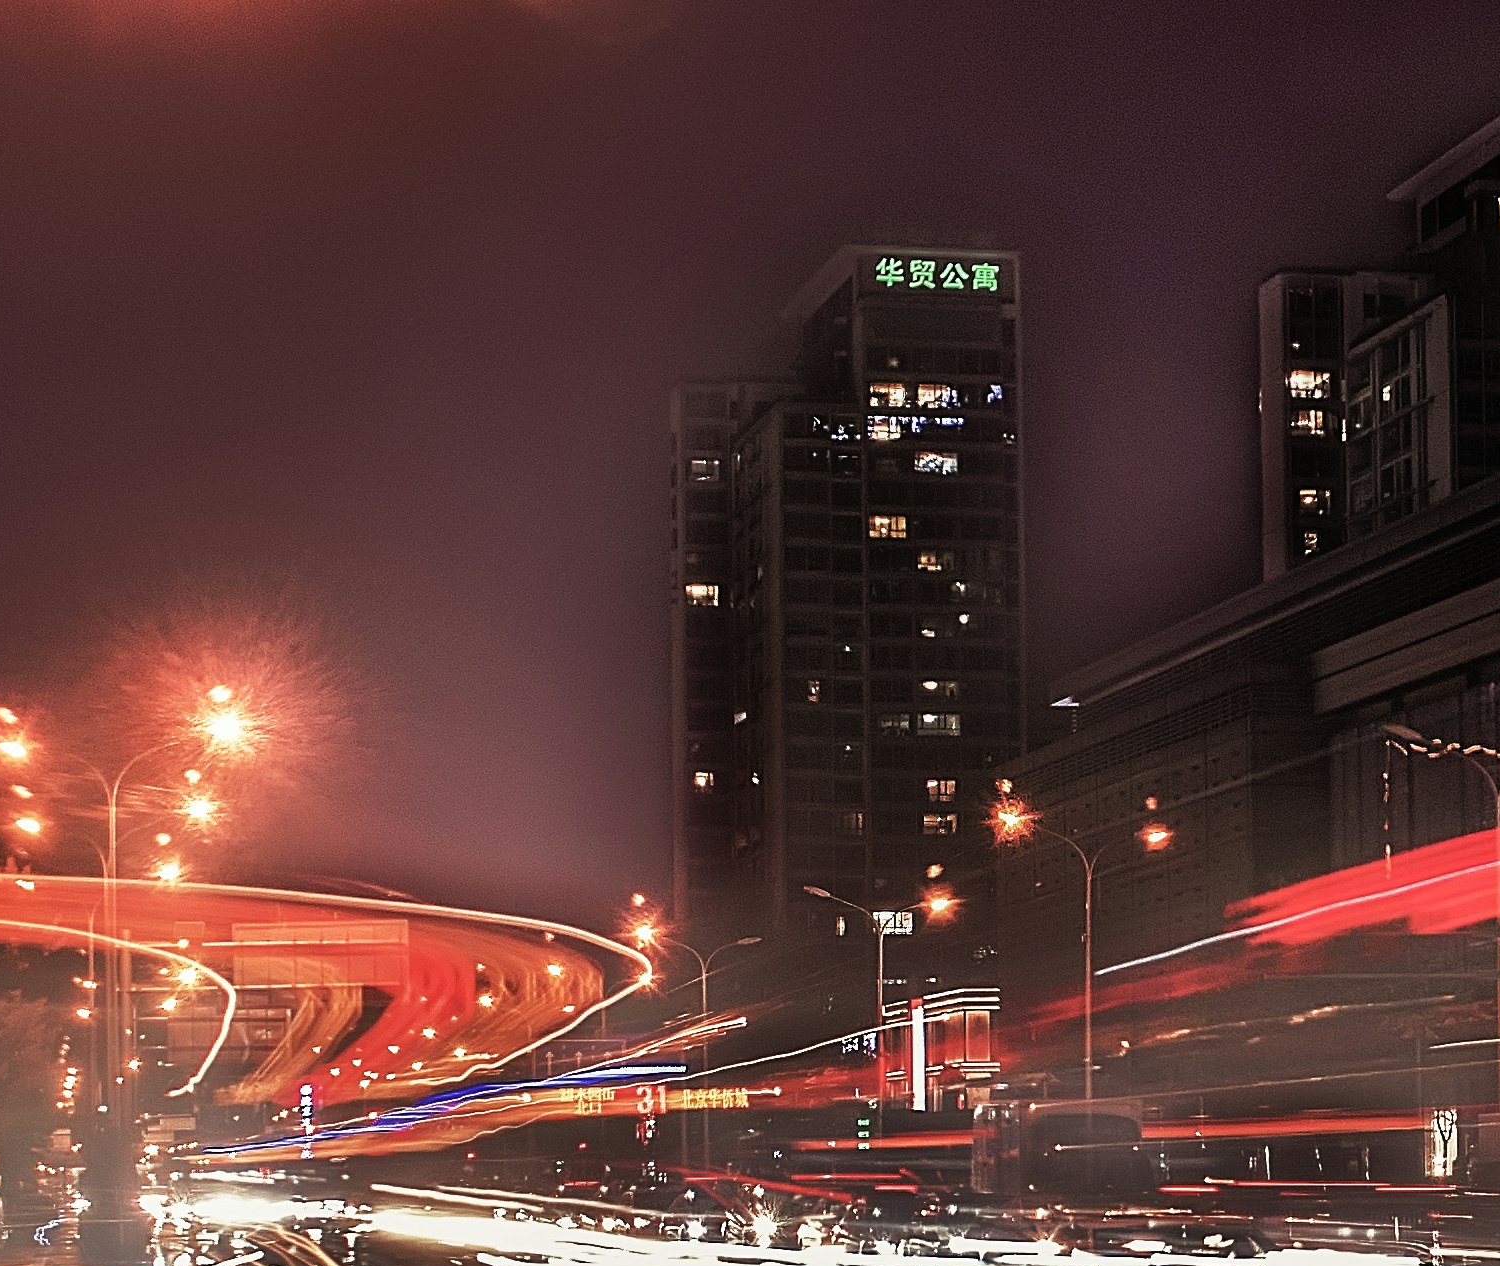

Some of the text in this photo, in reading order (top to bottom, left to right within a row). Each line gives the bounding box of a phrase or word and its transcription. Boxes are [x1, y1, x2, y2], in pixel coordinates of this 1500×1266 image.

[875, 257, 1000, 292] 华贸公寓
[636, 1085, 666, 1114] 31
